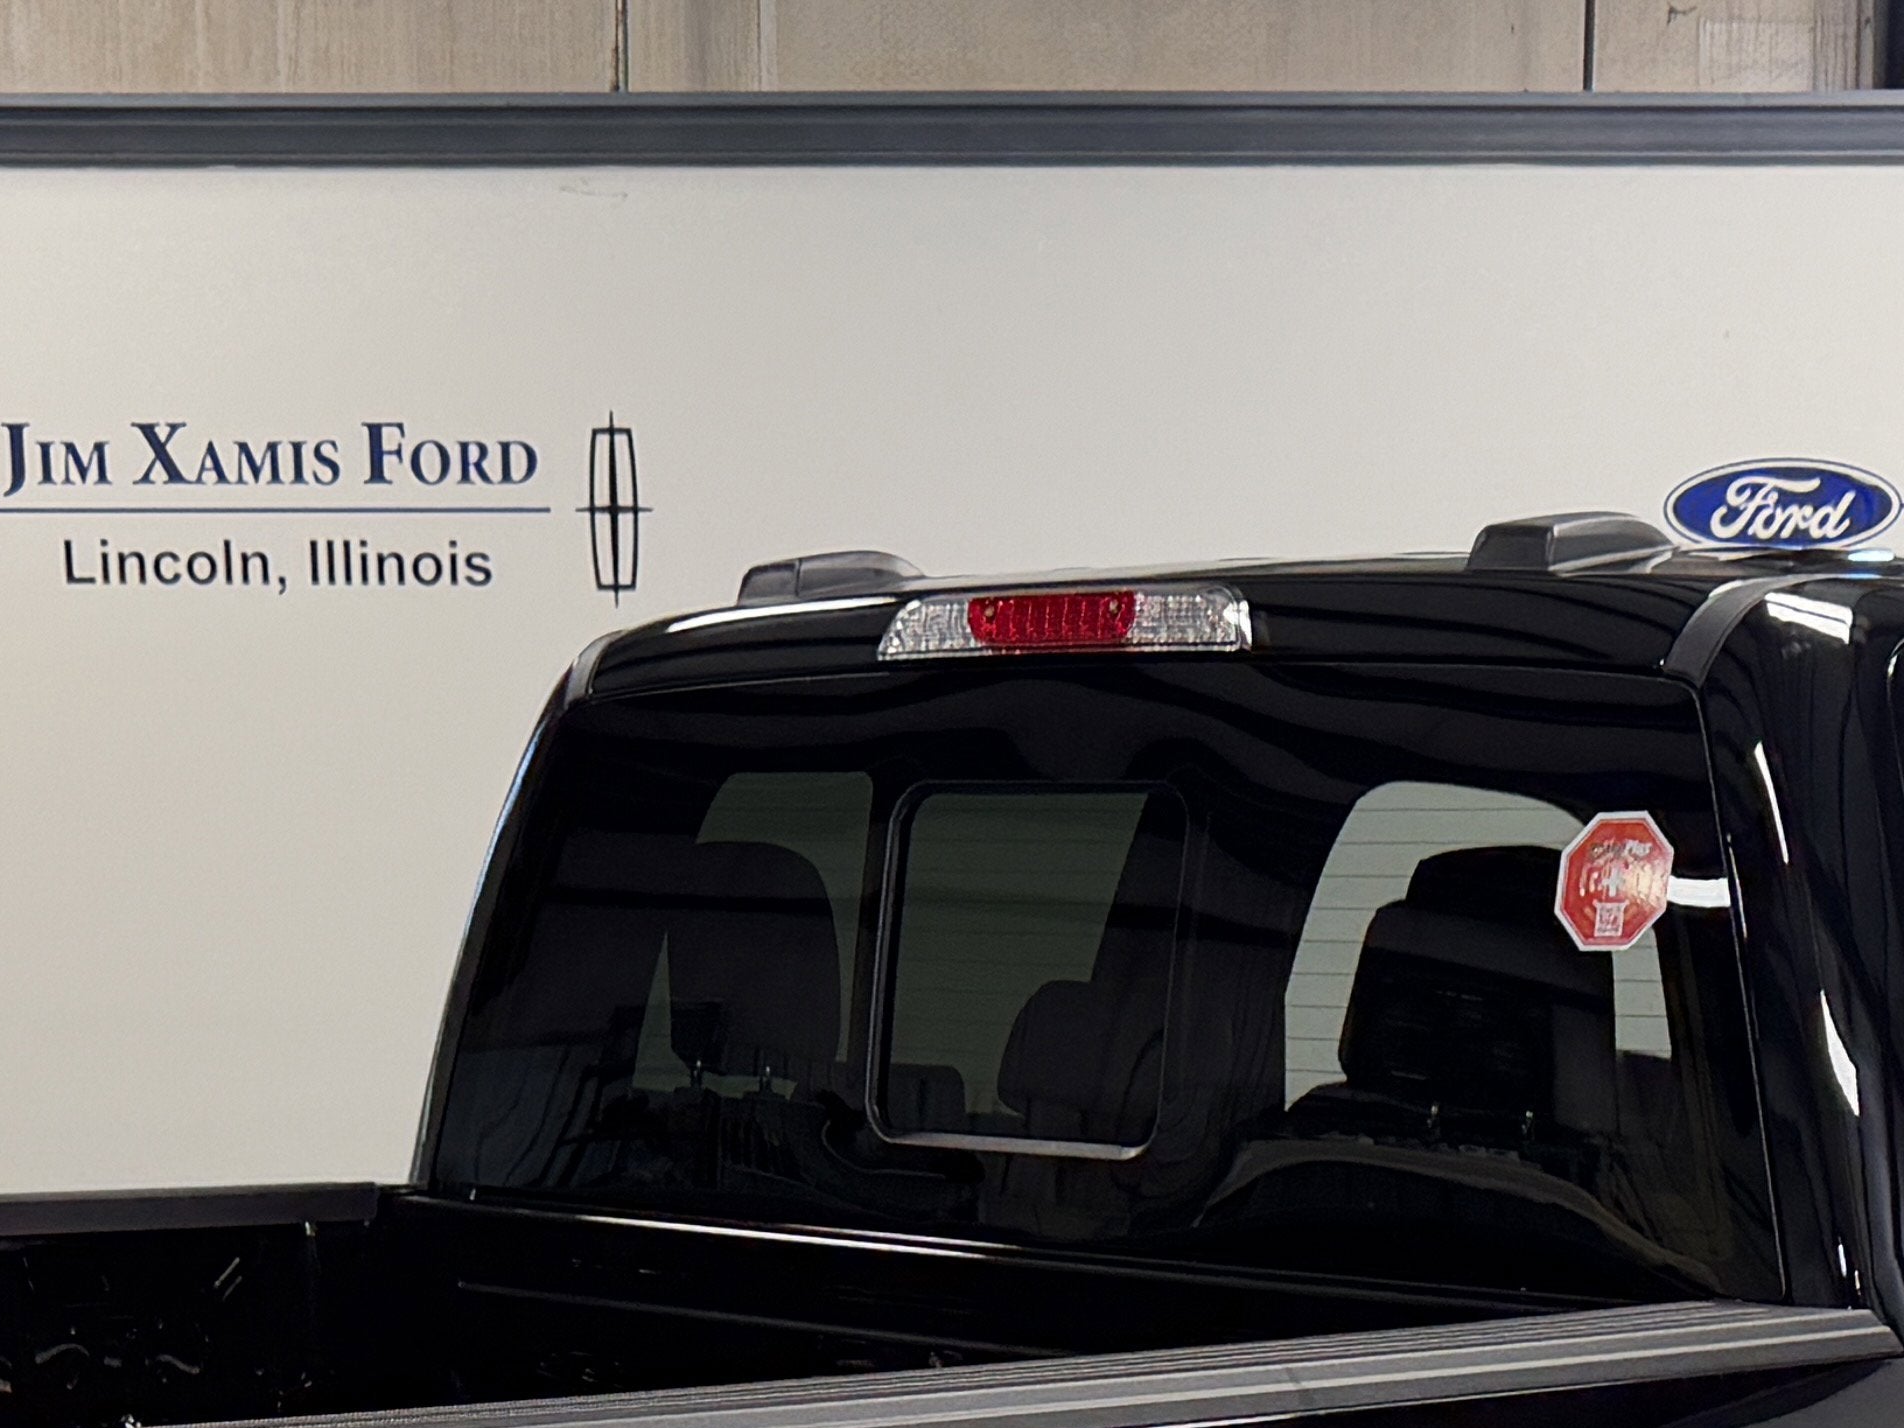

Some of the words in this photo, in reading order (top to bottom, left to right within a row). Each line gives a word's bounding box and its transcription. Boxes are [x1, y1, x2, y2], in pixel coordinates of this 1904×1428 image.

[0, 422, 109, 497] JIM
[130, 422, 342, 488] XAMIS
[361, 421, 539, 487] FORD
[1711, 475, 1852, 541] Ford
[63, 539, 289, 595] Lincoln,
[308, 538, 493, 587] Illinois
